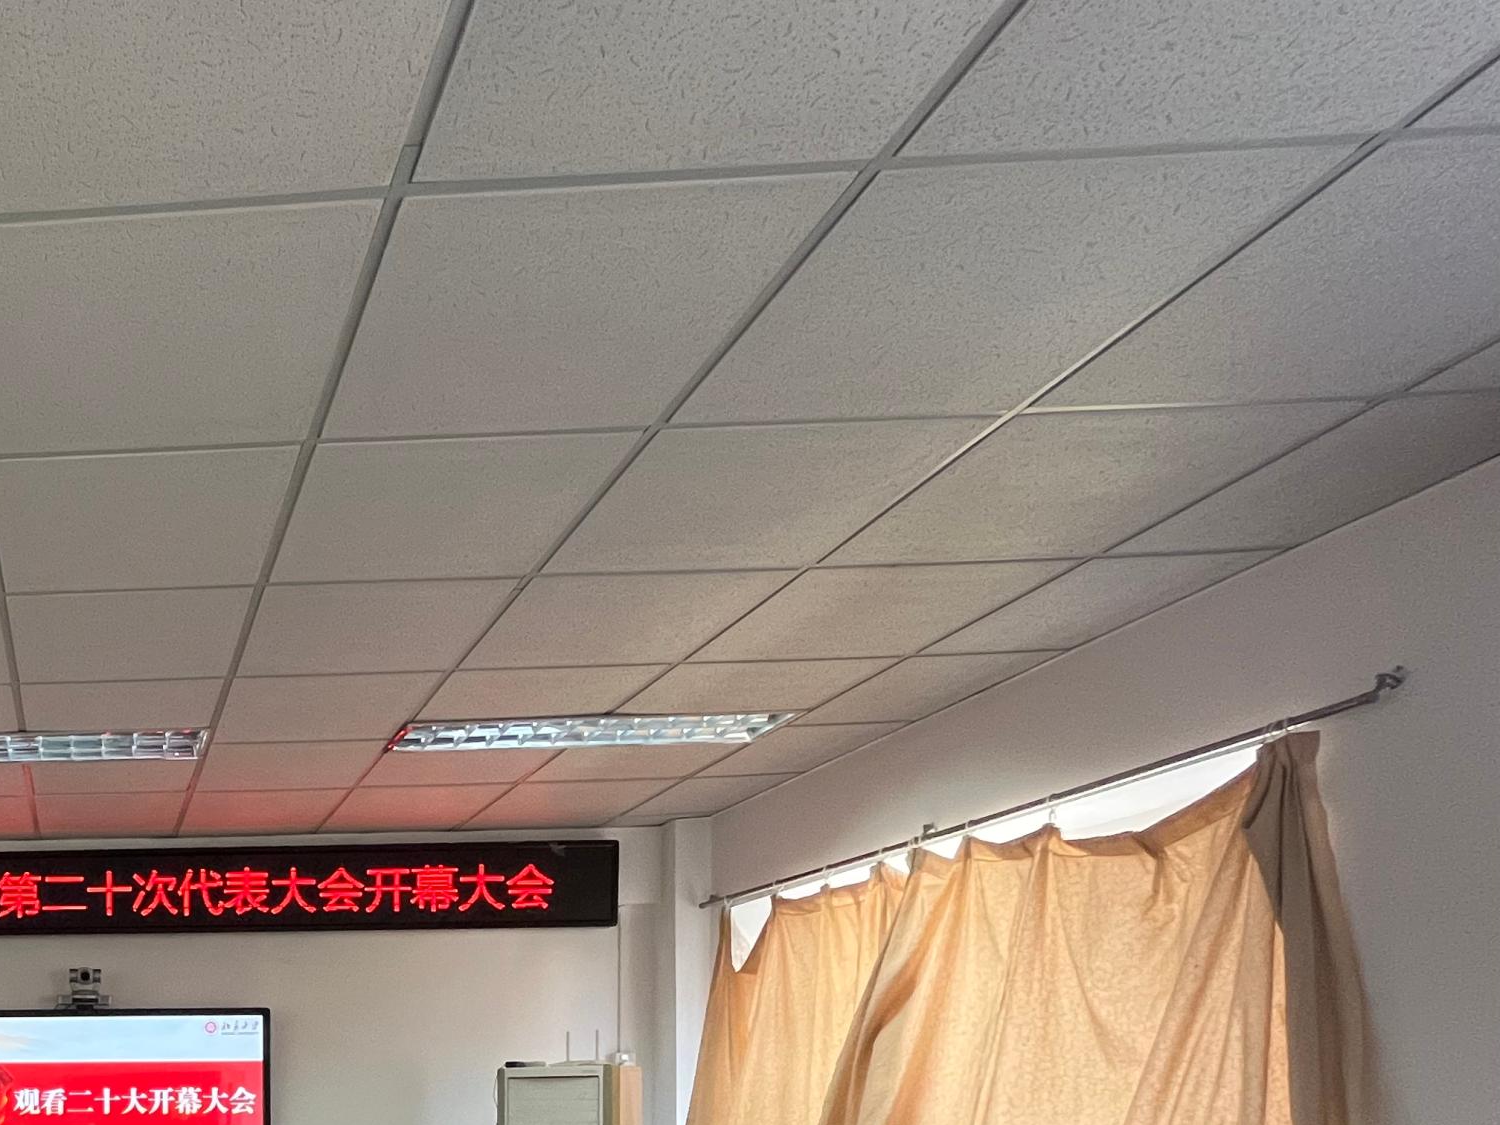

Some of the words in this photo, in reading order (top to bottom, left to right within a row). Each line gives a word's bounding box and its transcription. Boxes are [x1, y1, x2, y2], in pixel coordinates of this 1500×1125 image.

[12, 1086, 257, 1117] 观看二十大开幕大会
